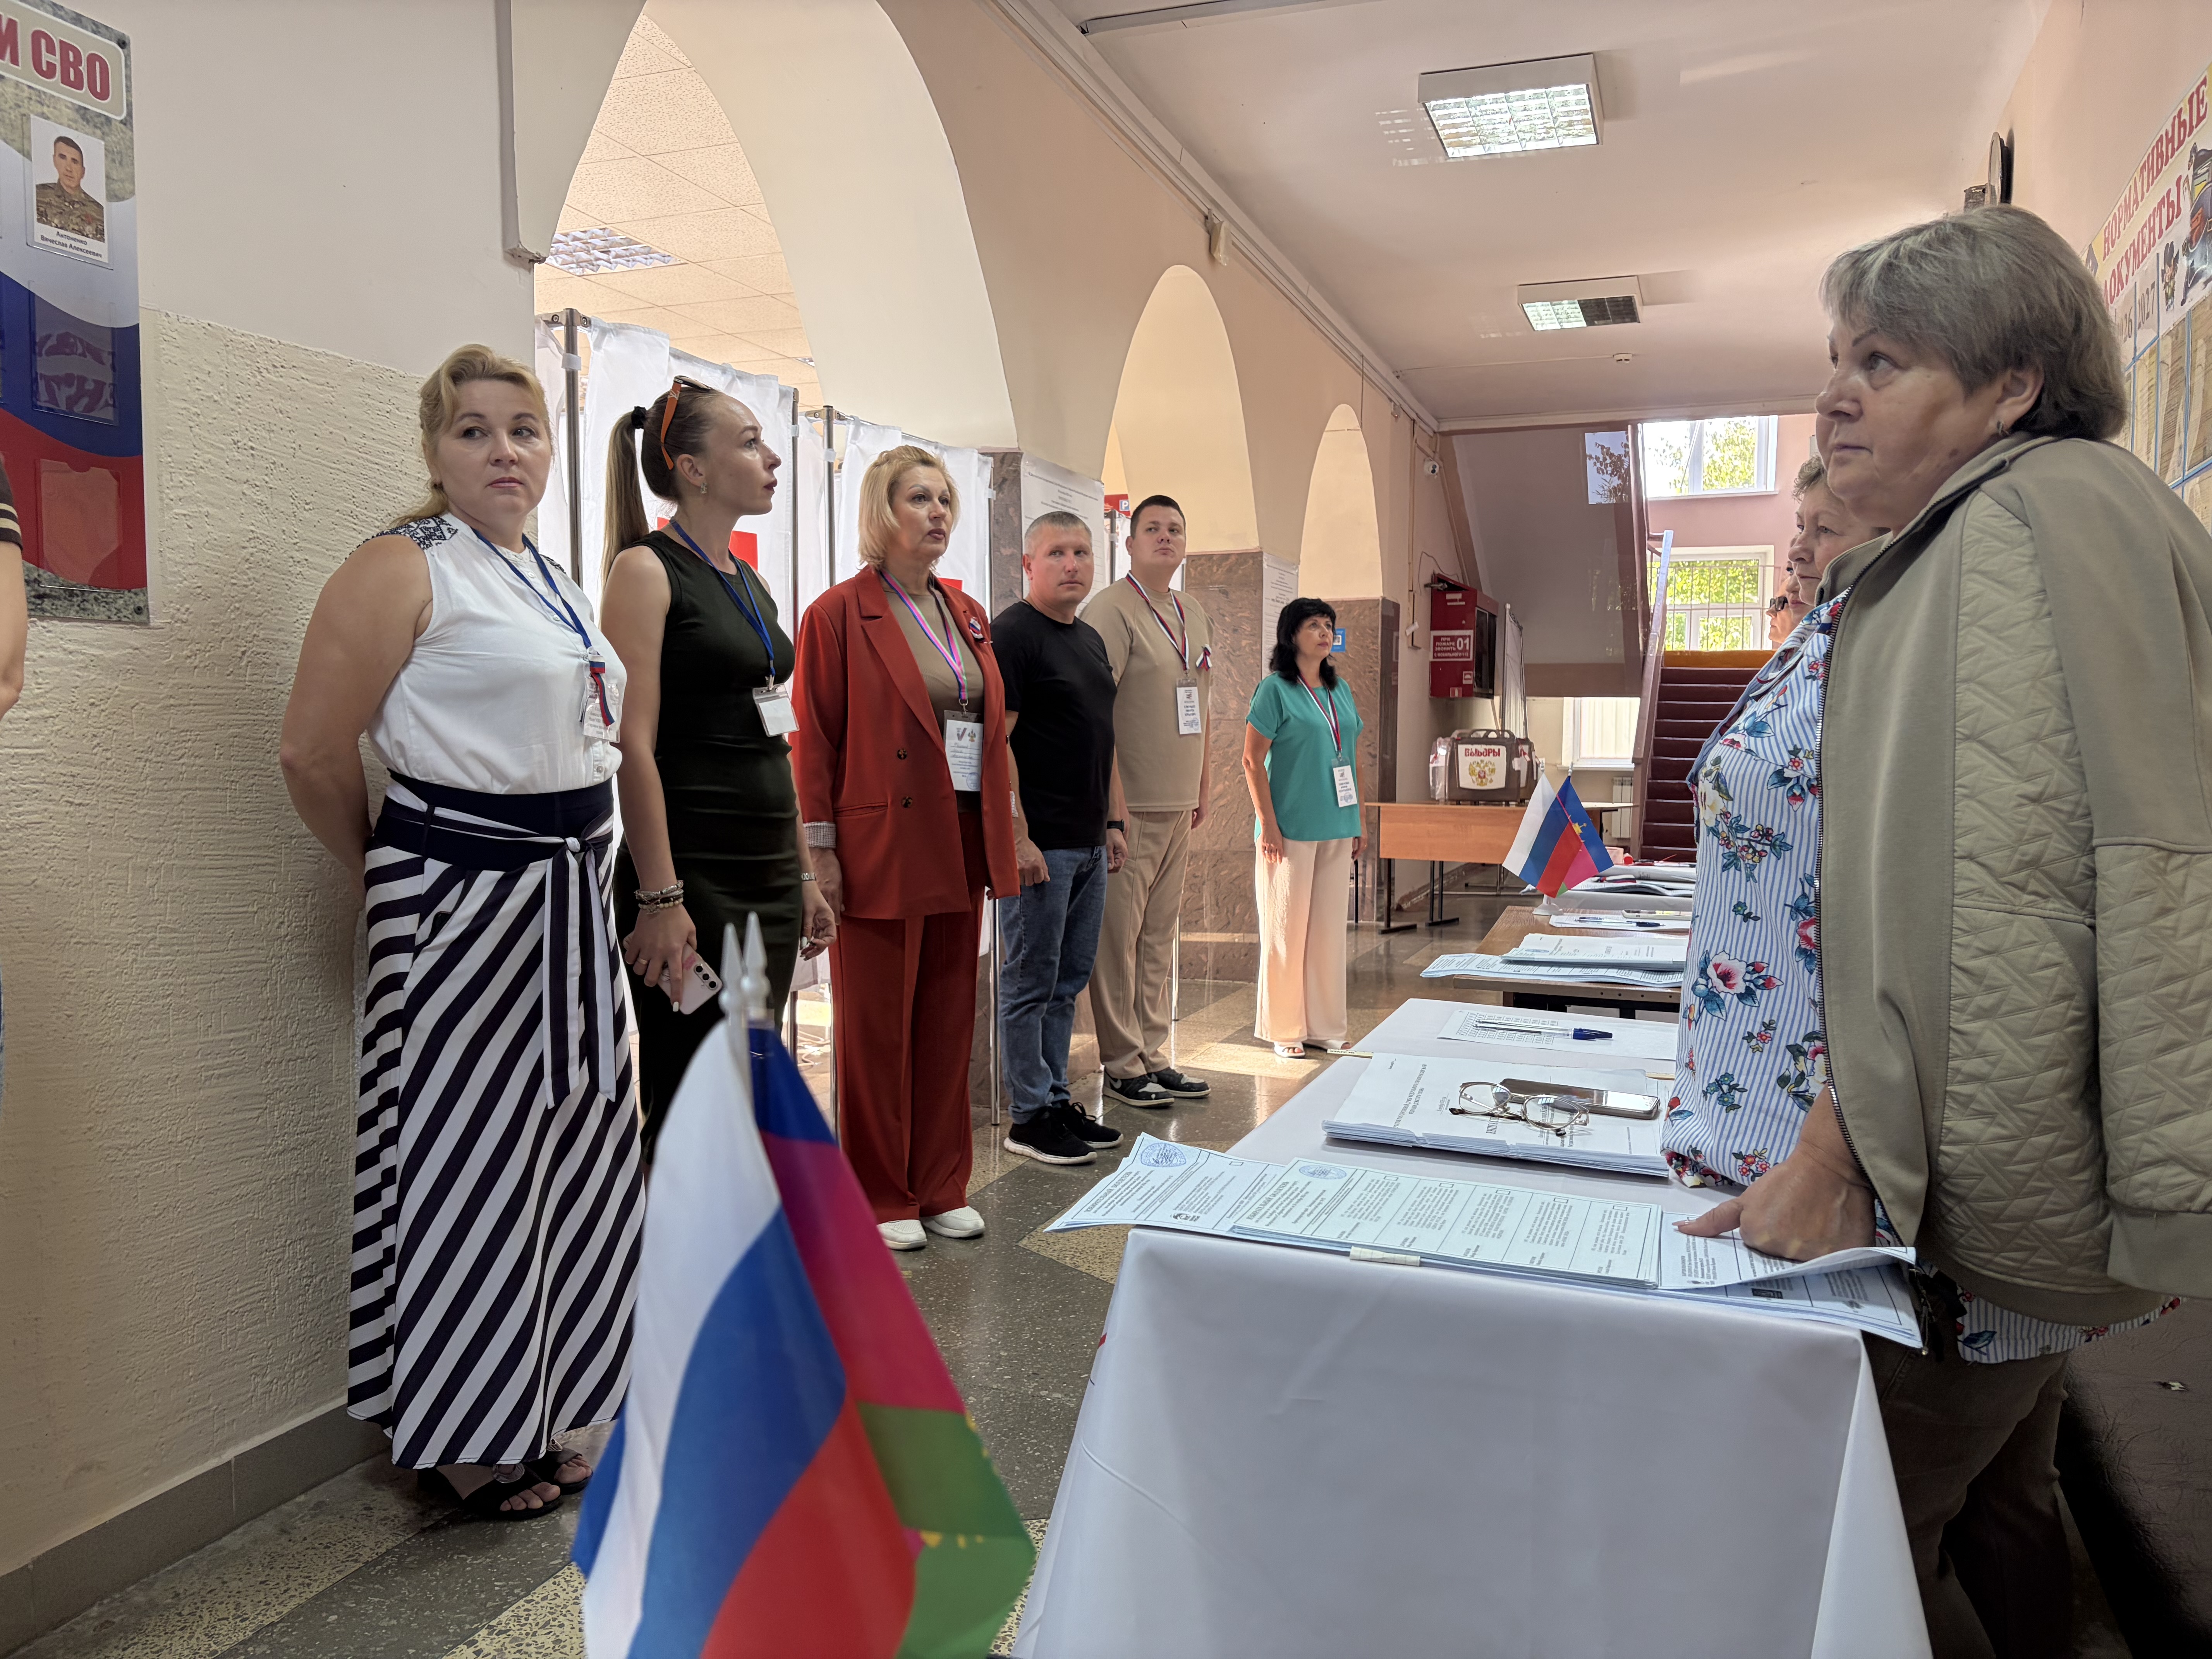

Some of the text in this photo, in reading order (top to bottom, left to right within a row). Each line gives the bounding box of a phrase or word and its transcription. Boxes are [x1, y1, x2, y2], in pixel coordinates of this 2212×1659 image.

[31, 29, 110, 101] СВО
[2103, 75, 2207, 261] НОРМАТИВНЫЕ
[41, 235, 102, 258] Вячеслав Алексеевич
[56, 231, 88, 245] Антоненко
[2138, 281, 2155, 331] 2027
[1456, 637, 1469, 651] 01
[1465, 748, 1501, 757] ВЫБОРЫ
